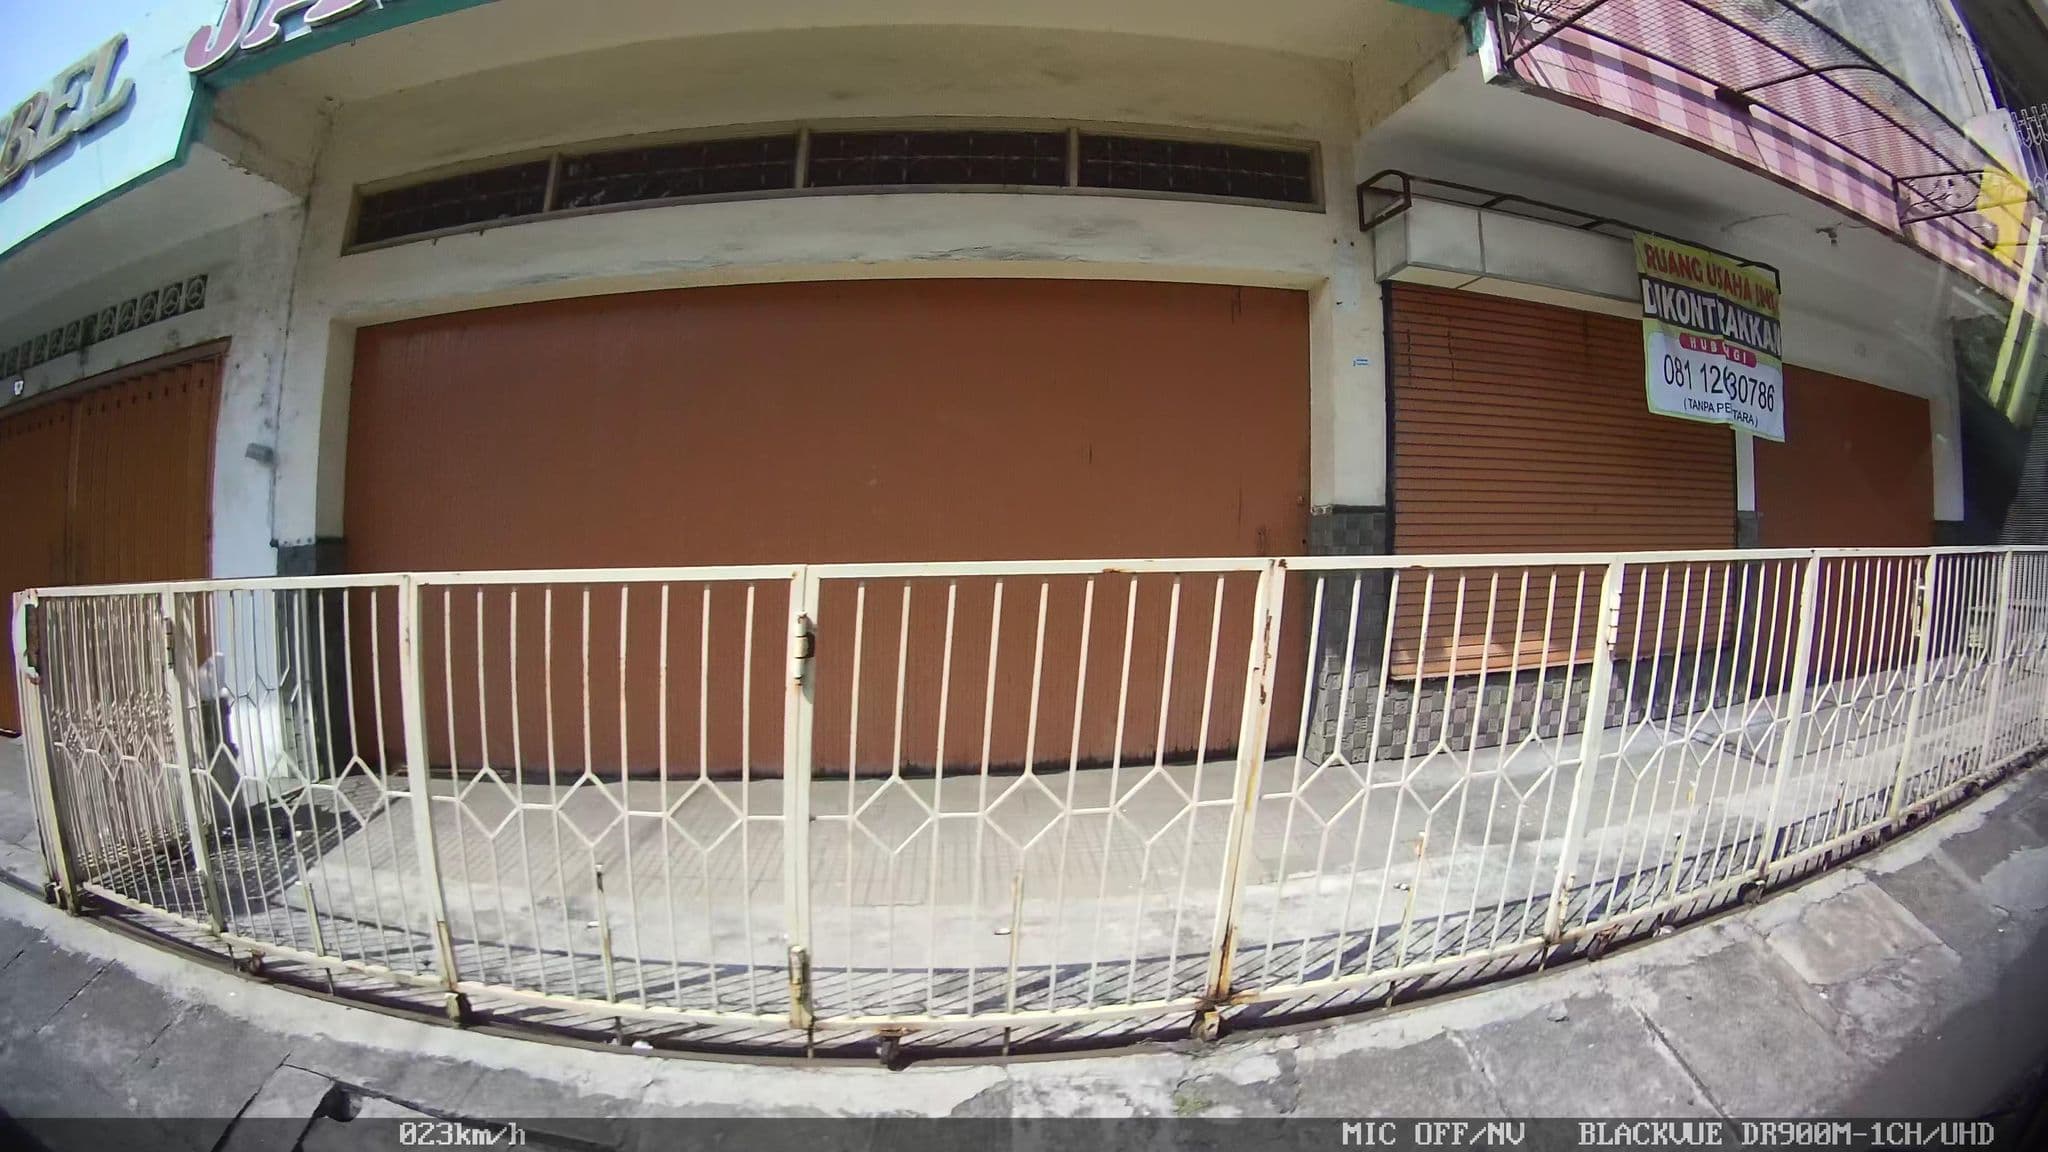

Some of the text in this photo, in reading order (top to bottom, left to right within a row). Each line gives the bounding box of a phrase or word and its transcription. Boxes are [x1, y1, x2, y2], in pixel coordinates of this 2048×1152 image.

[1645, 244, 1702, 281] RUANG
[1707, 263, 1752, 301] USAHA
[1664, 354, 1692, 390] 081
